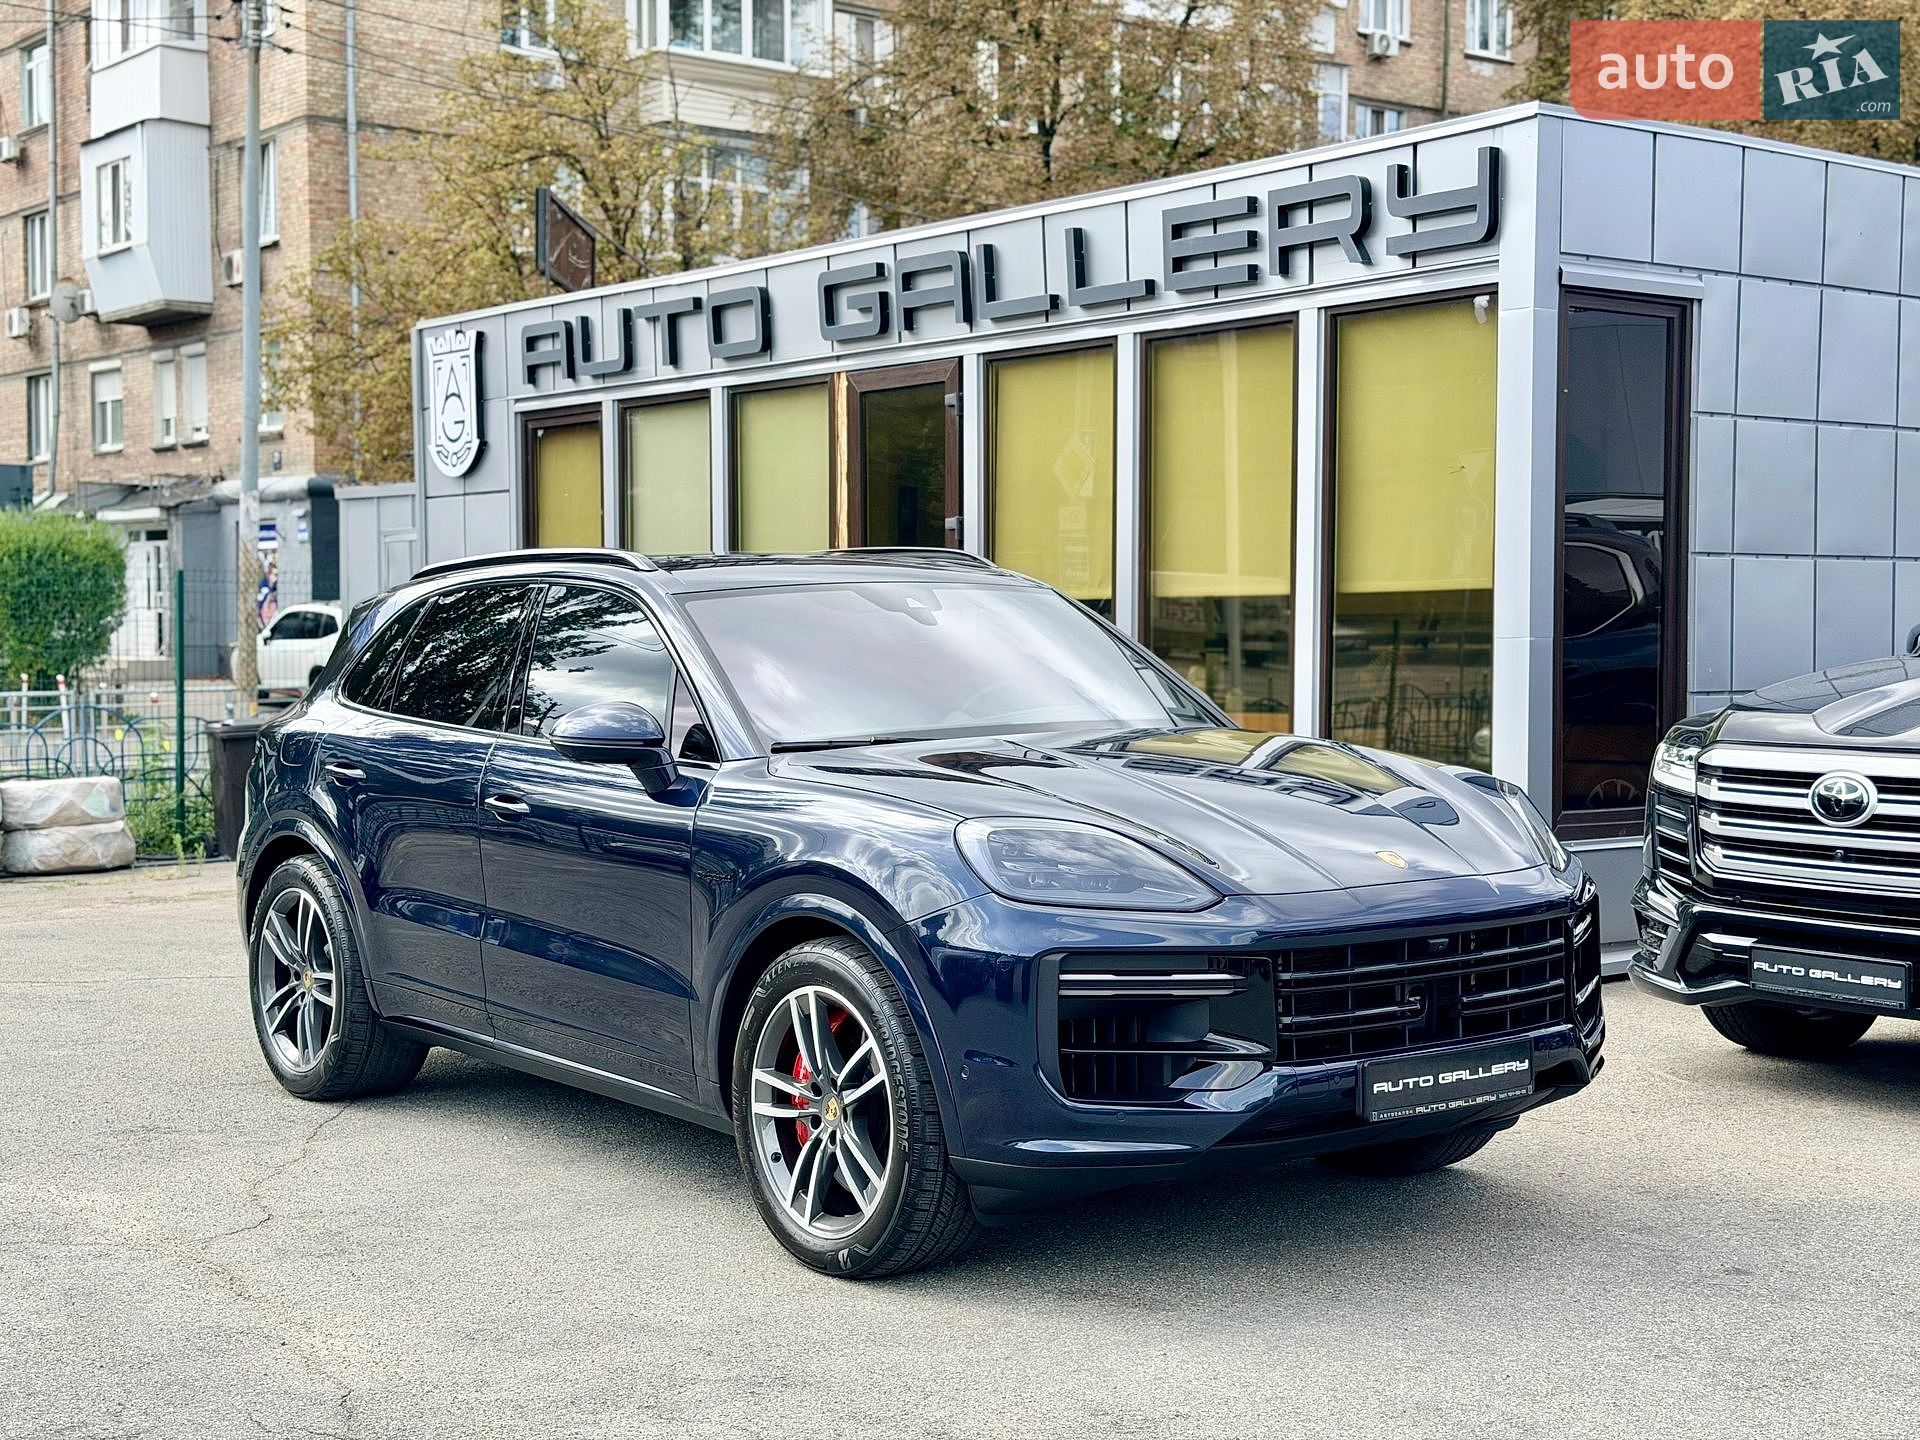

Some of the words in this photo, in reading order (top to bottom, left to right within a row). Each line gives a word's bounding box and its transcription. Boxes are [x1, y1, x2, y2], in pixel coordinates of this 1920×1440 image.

[521, 286, 771, 385] AUTO
[818, 146, 1503, 342] GALLERY
[1753, 961, 1804, 977] AUTO
[1808, 968, 1901, 988] GALLERY
[1373, 1075, 1434, 1094] AUTO
[1438, 1059, 1529, 1084] GALLERY
[1415, 1103, 1446, 1114] AUTO
[1448, 1093, 1497, 1108] GALLERY
